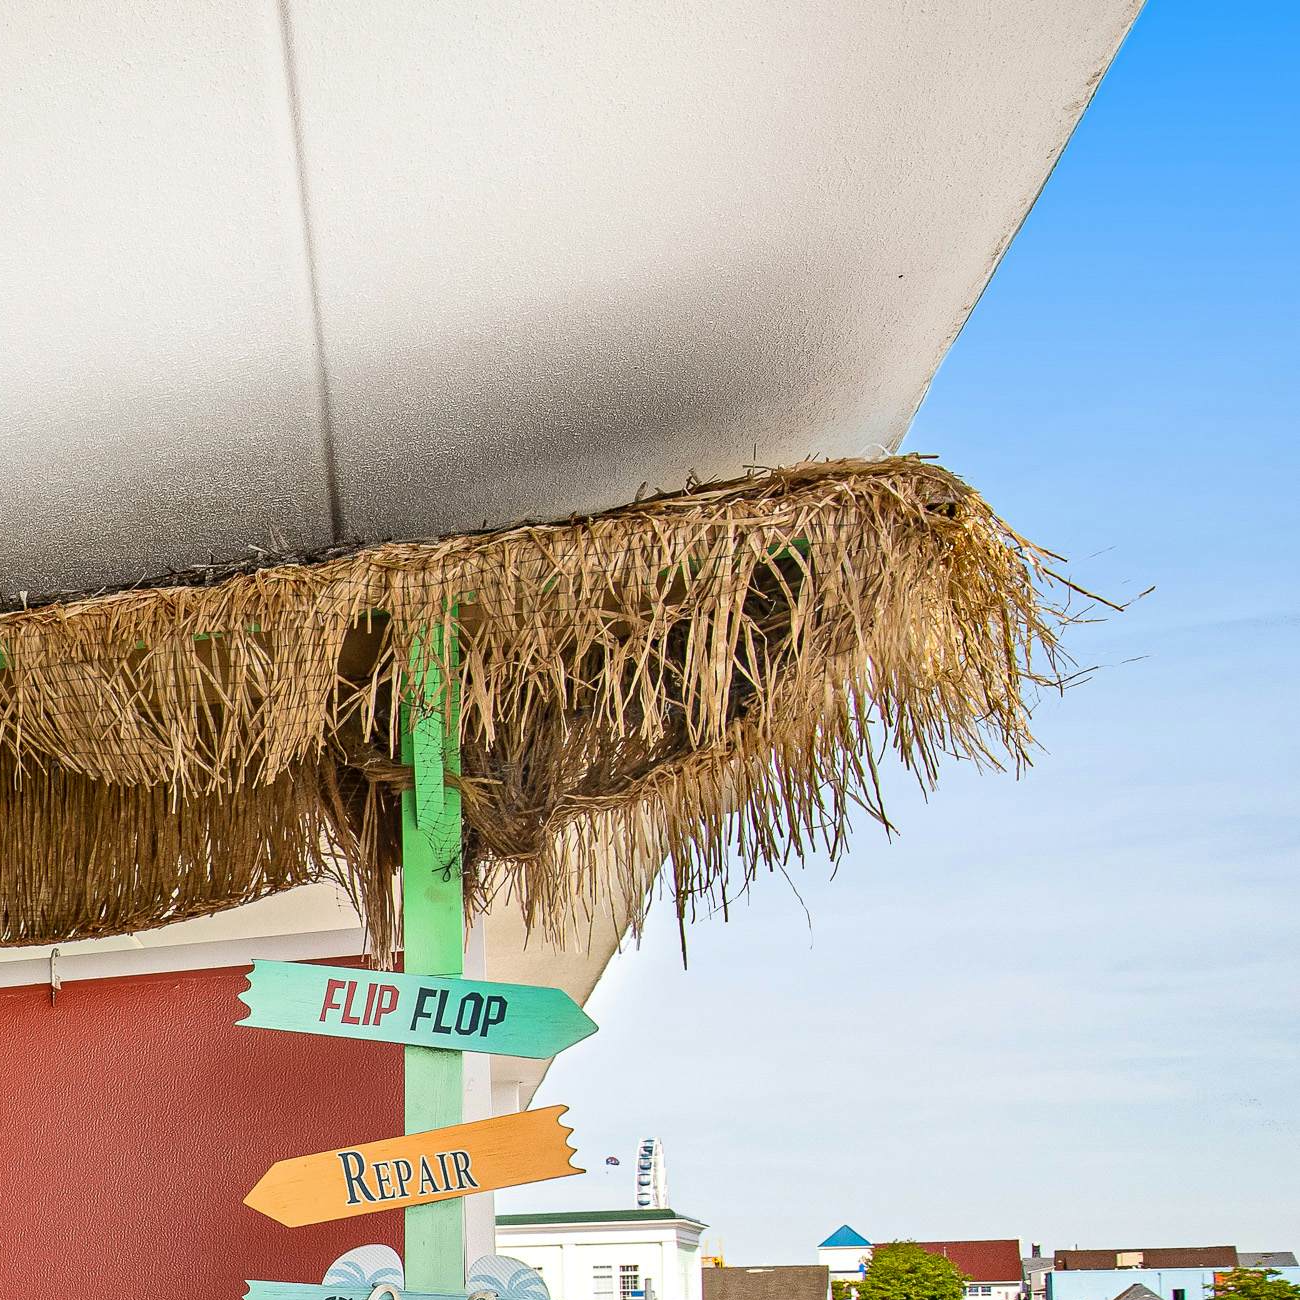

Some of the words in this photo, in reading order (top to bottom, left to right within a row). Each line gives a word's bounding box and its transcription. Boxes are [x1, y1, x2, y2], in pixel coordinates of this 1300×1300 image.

[319, 978, 400, 1026] FLIP
[410, 987, 508, 1037] FLOP
[338, 1151, 478, 1204] REPAIR
